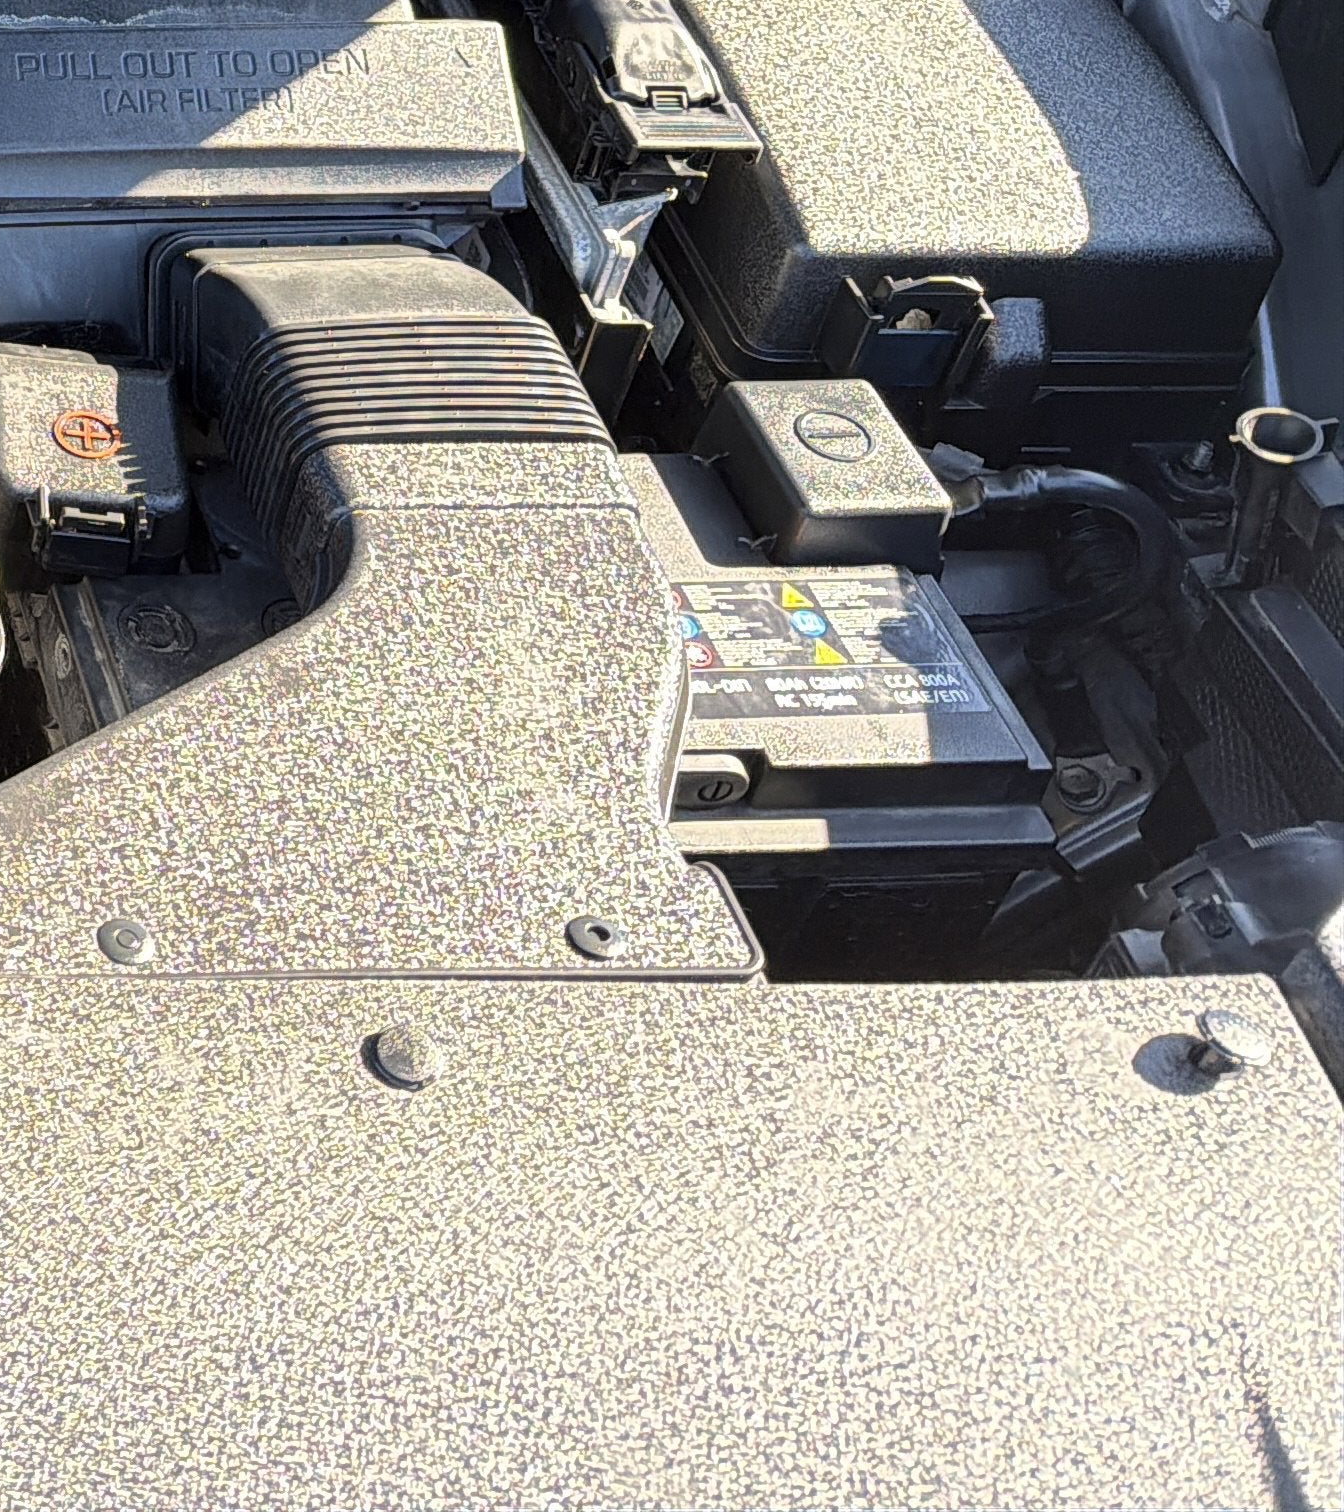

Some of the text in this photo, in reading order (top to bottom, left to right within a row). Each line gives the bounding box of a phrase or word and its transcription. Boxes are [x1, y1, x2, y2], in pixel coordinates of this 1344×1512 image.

[15, 47, 371, 81] PULL OUT TO OPEN
[883, 673, 961, 689] CCA 800A
